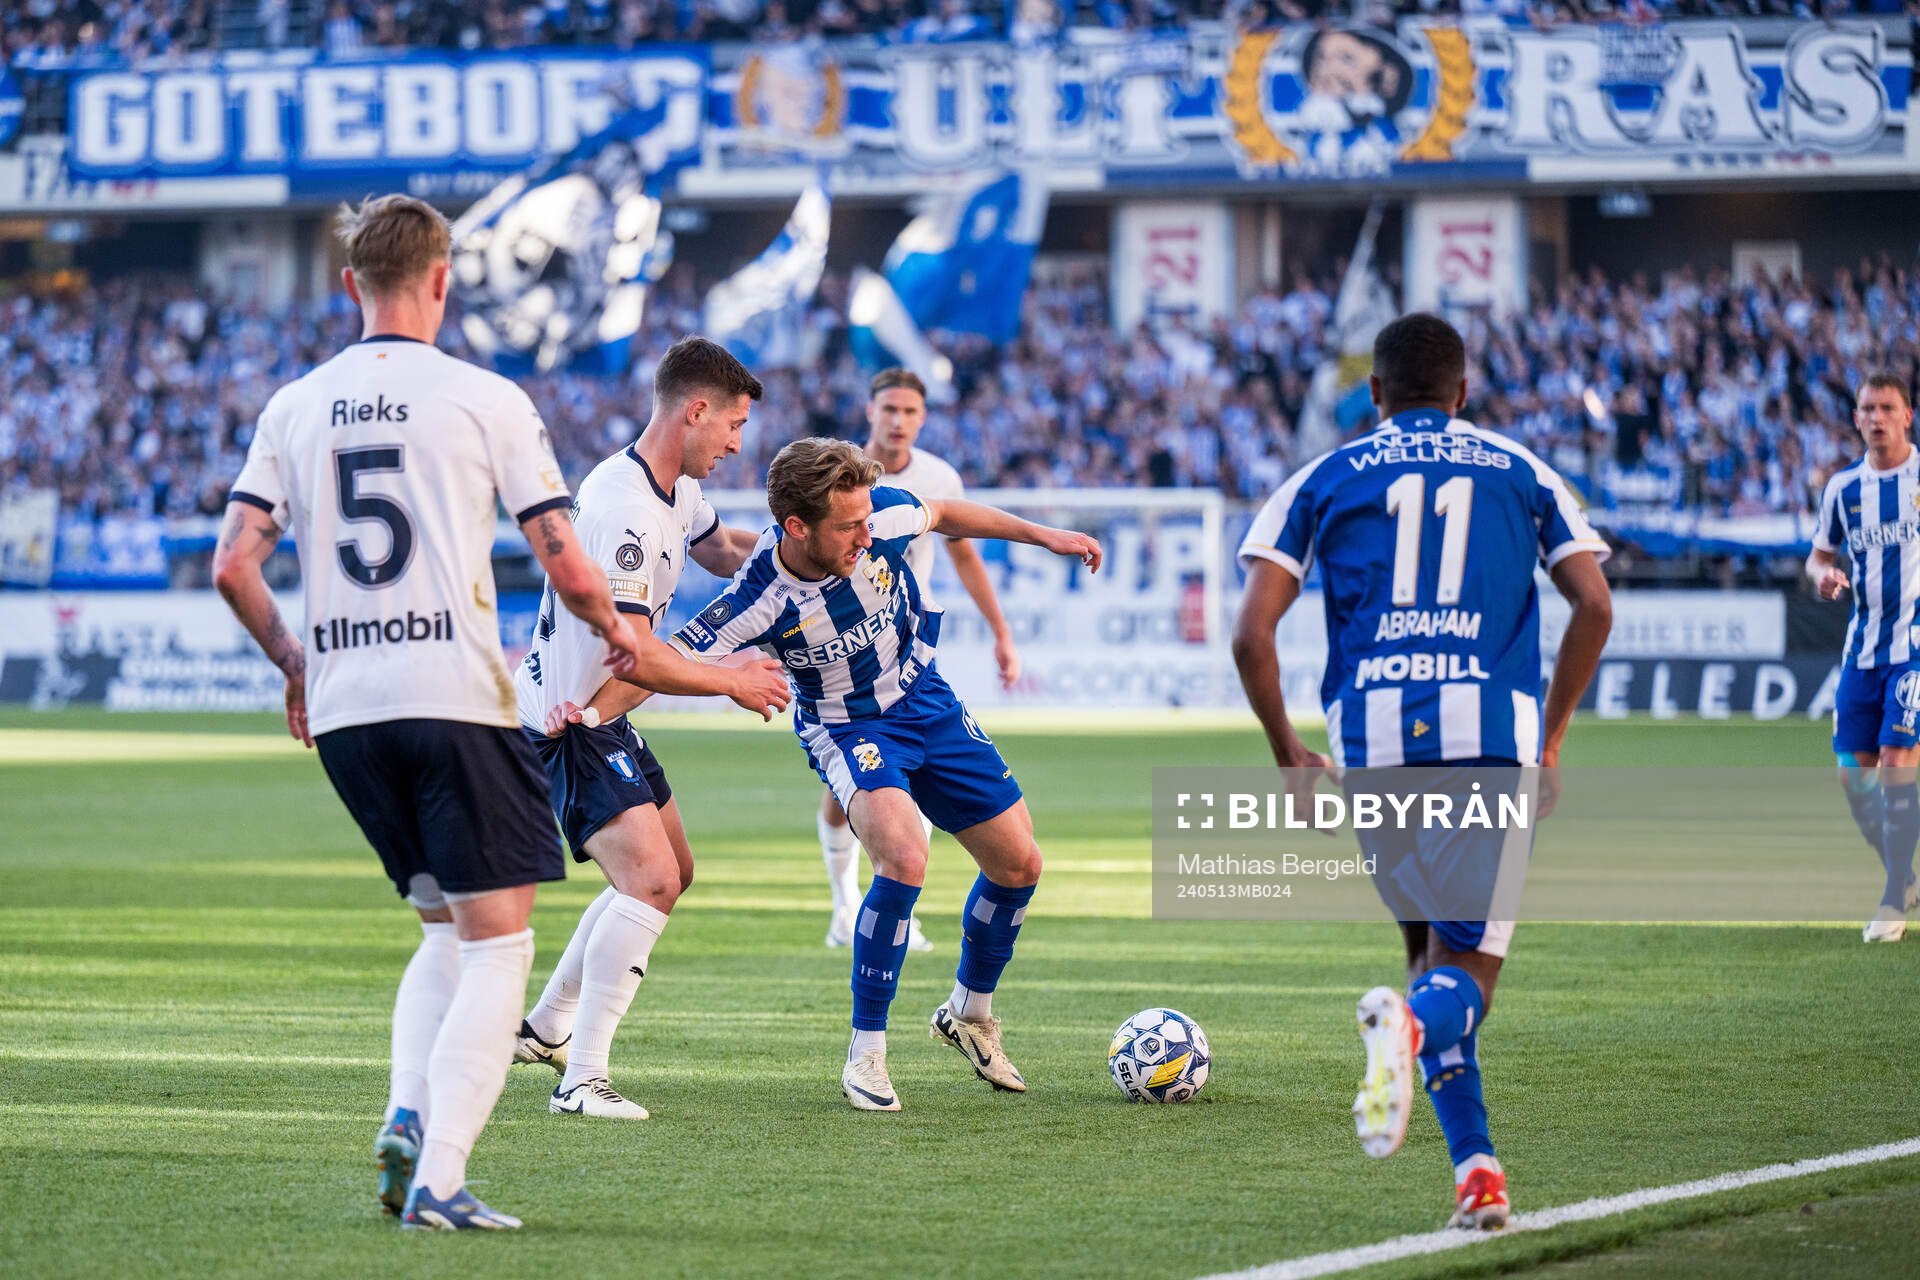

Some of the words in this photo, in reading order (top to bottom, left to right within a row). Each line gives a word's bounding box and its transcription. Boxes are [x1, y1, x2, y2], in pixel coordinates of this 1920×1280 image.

[331, 395, 410, 427] Rieks
[1373, 432, 1482, 450] NORDIC
[1349, 449, 1511, 472] WELLNESS
[334, 444, 416, 590] 5
[1386, 473, 1474, 606] 11
[609, 579, 646, 593] UNIBET
[687, 620, 715, 645] NIBET
[1375, 609, 1482, 642] ABRAHAM
[1355, 653, 1490, 689] MOBILL
